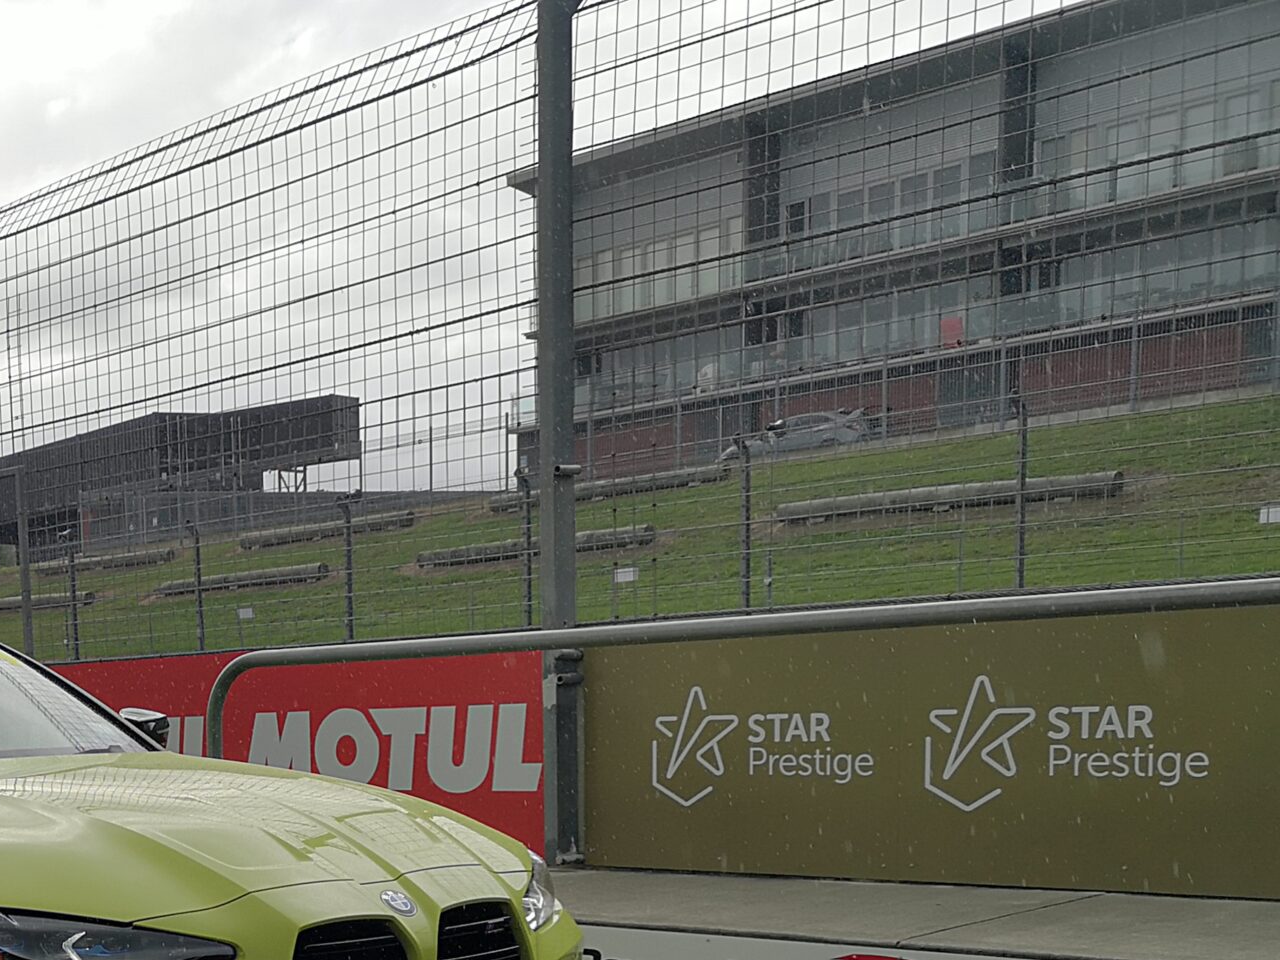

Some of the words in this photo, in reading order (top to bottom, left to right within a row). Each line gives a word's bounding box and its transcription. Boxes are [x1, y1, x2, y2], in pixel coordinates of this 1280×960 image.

[747, 712, 831, 743] STAR
[1047, 705, 1154, 740] STAR
[248, 703, 543, 793] MOTUL
[748, 746, 874, 784] Prestige
[1048, 744, 1209, 786] Prestige
